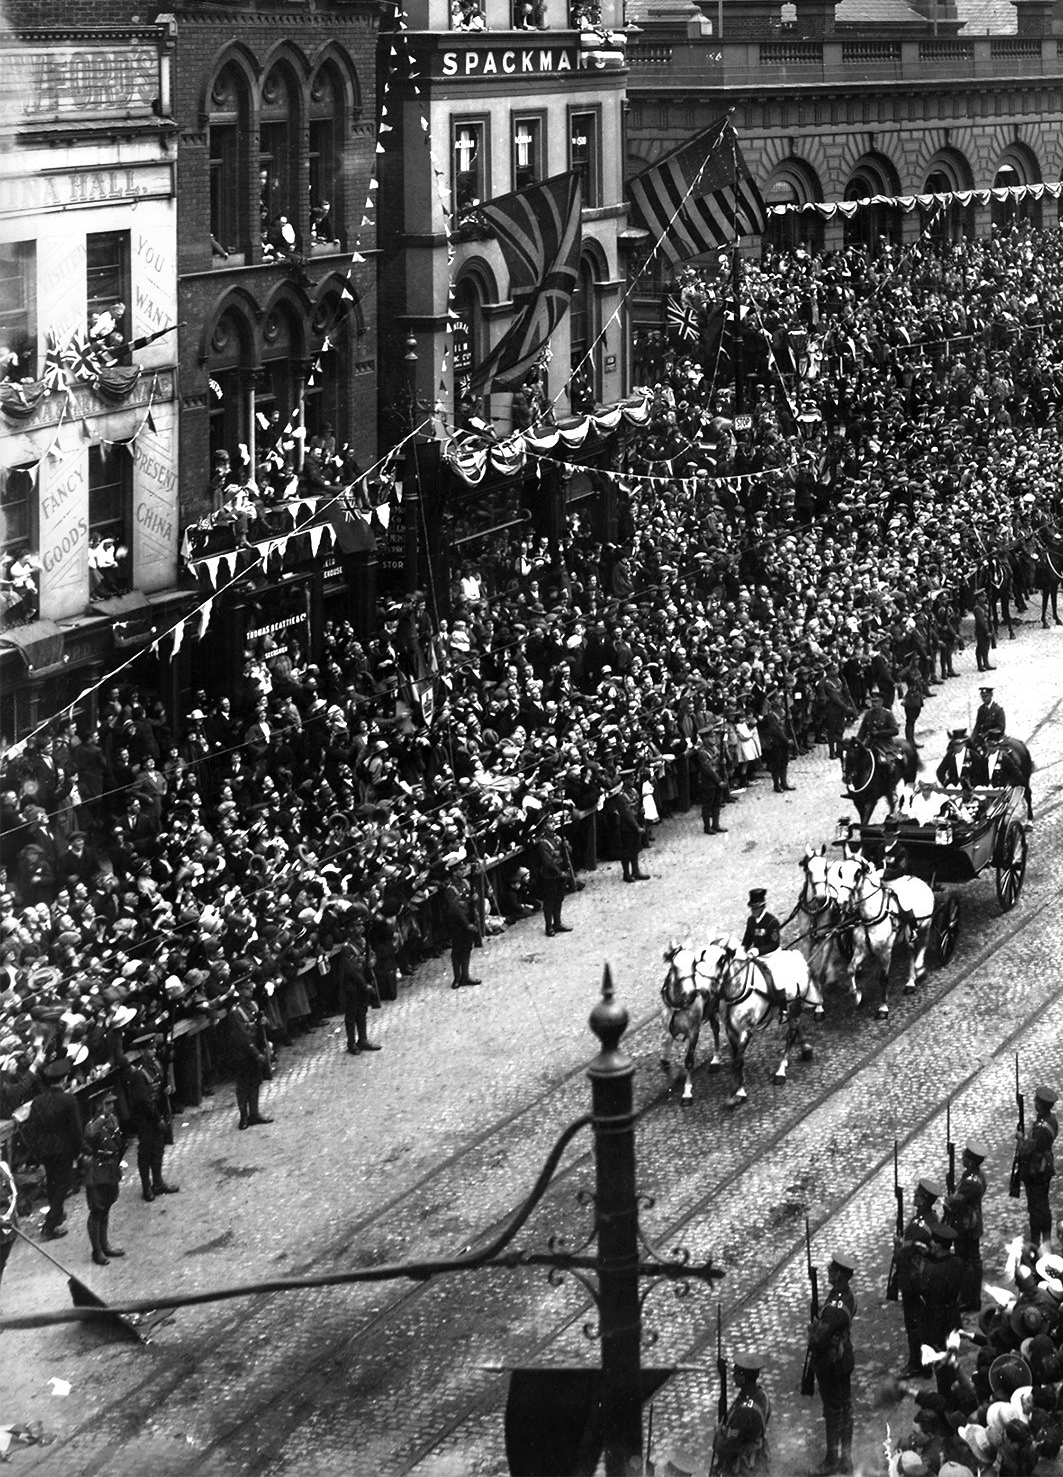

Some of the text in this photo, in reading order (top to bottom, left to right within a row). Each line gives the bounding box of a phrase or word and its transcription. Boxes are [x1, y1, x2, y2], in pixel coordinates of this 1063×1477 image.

[135, 234, 165, 273] YOU
[135, 285, 172, 328] WANT
[133, 446, 179, 492] PRESENT
[41, 464, 85, 520] FANCY
[136, 502, 173, 542] CHINA
[42, 517, 88, 573] GOODS
[246, 625, 270, 640] THOMAS
